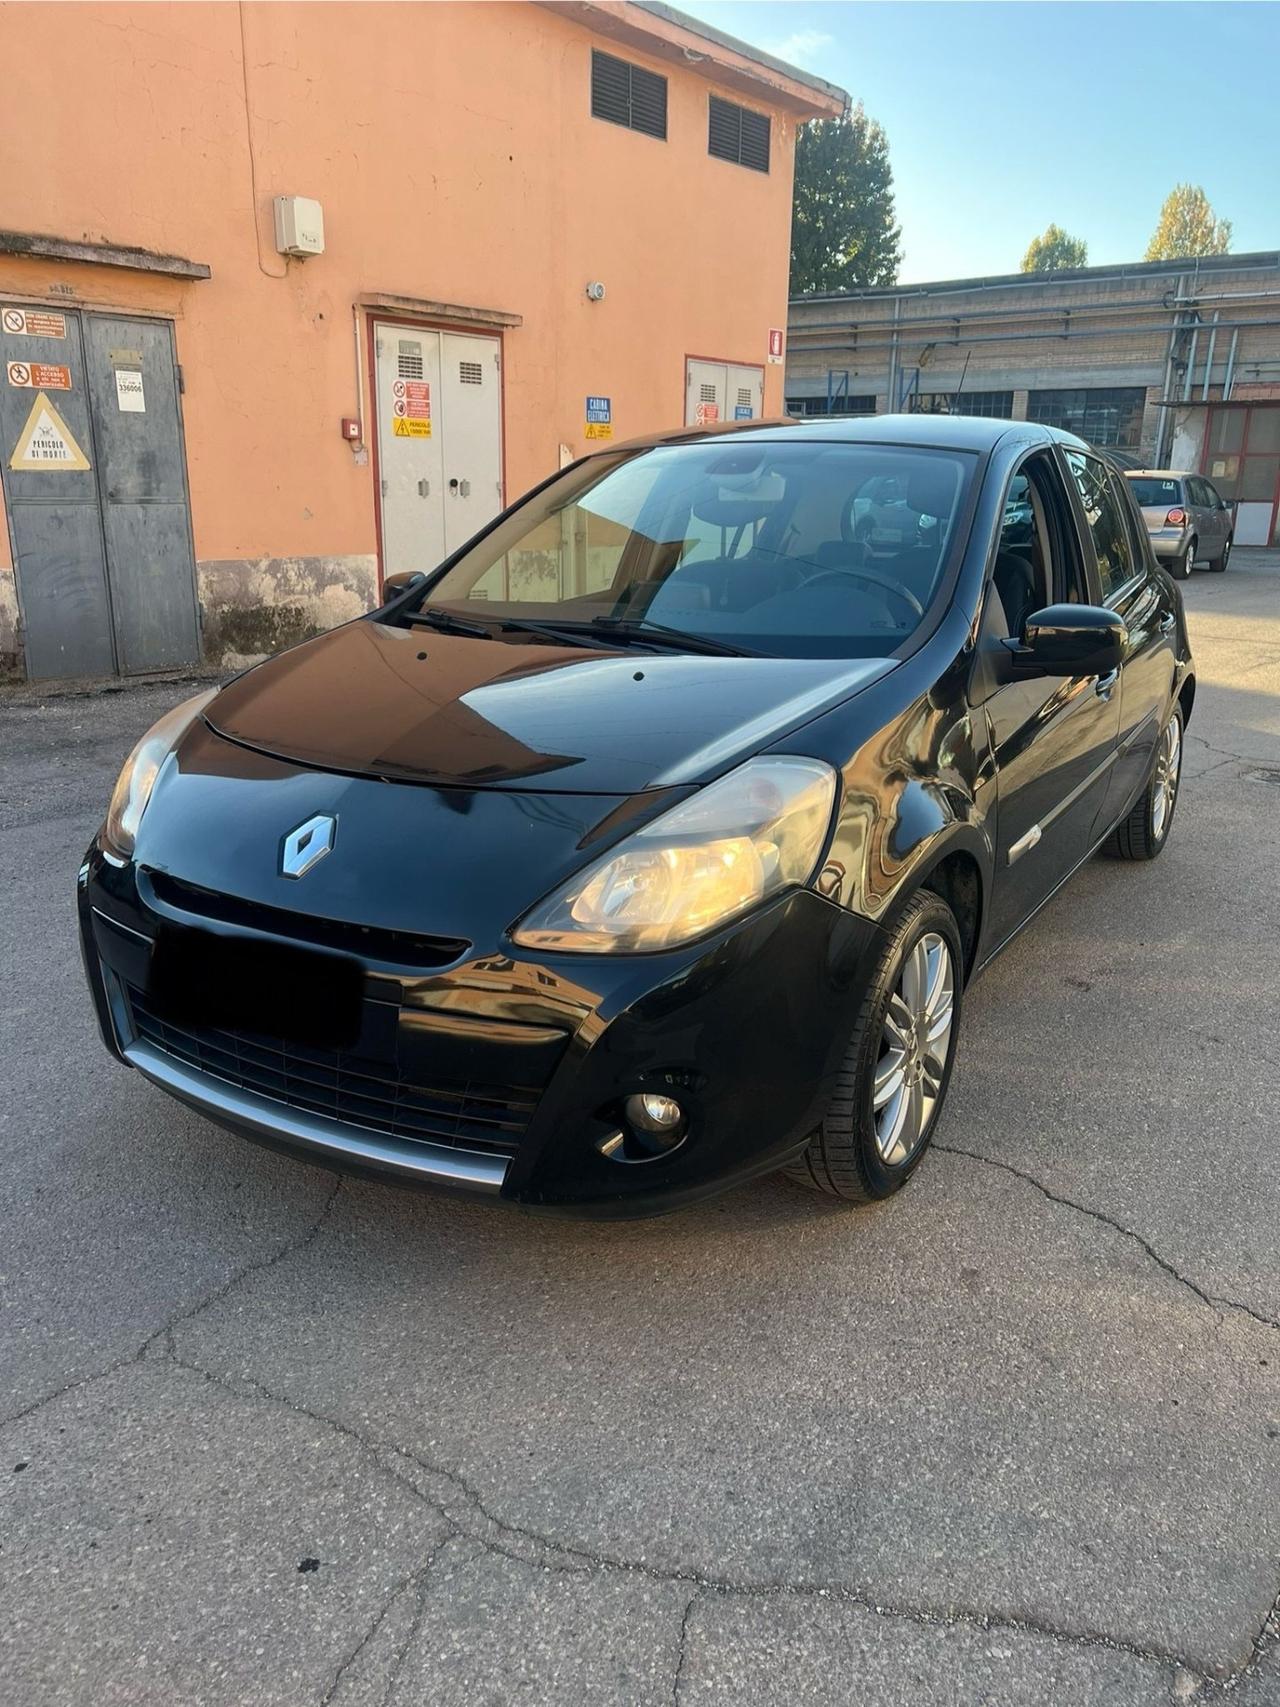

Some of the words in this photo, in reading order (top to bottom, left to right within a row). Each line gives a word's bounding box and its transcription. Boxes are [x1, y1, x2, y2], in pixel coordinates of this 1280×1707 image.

[589, 398, 608, 410] CABINA
[588, 410, 610, 421] ELETTRICA
[32, 440, 63, 449] PERICOLO
[31, 450, 39, 459] DI
[43, 450, 67, 459] MORTE
